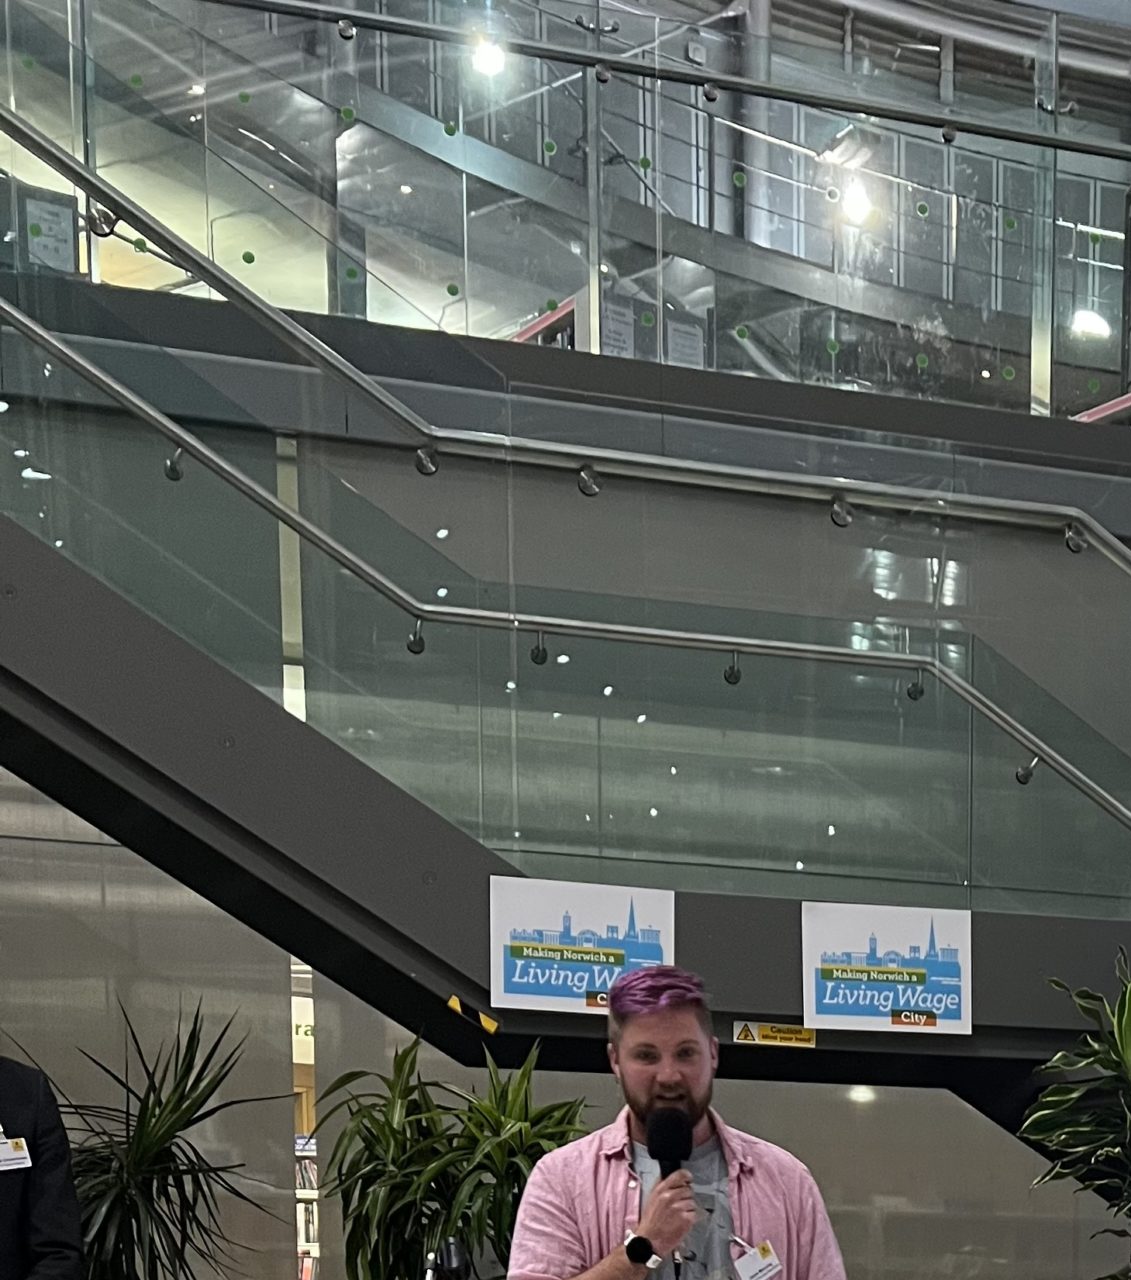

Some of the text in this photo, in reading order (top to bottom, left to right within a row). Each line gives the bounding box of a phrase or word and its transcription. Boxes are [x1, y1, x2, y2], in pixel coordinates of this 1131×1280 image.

[523, 946, 615, 963] Making Norwich a
[511, 960, 589, 992] Living
[833, 968, 868, 981] Making
[870, 970, 910, 982] Norwich
[823, 981, 960, 1014] Living Wage
[900, 1011, 928, 1026] City
